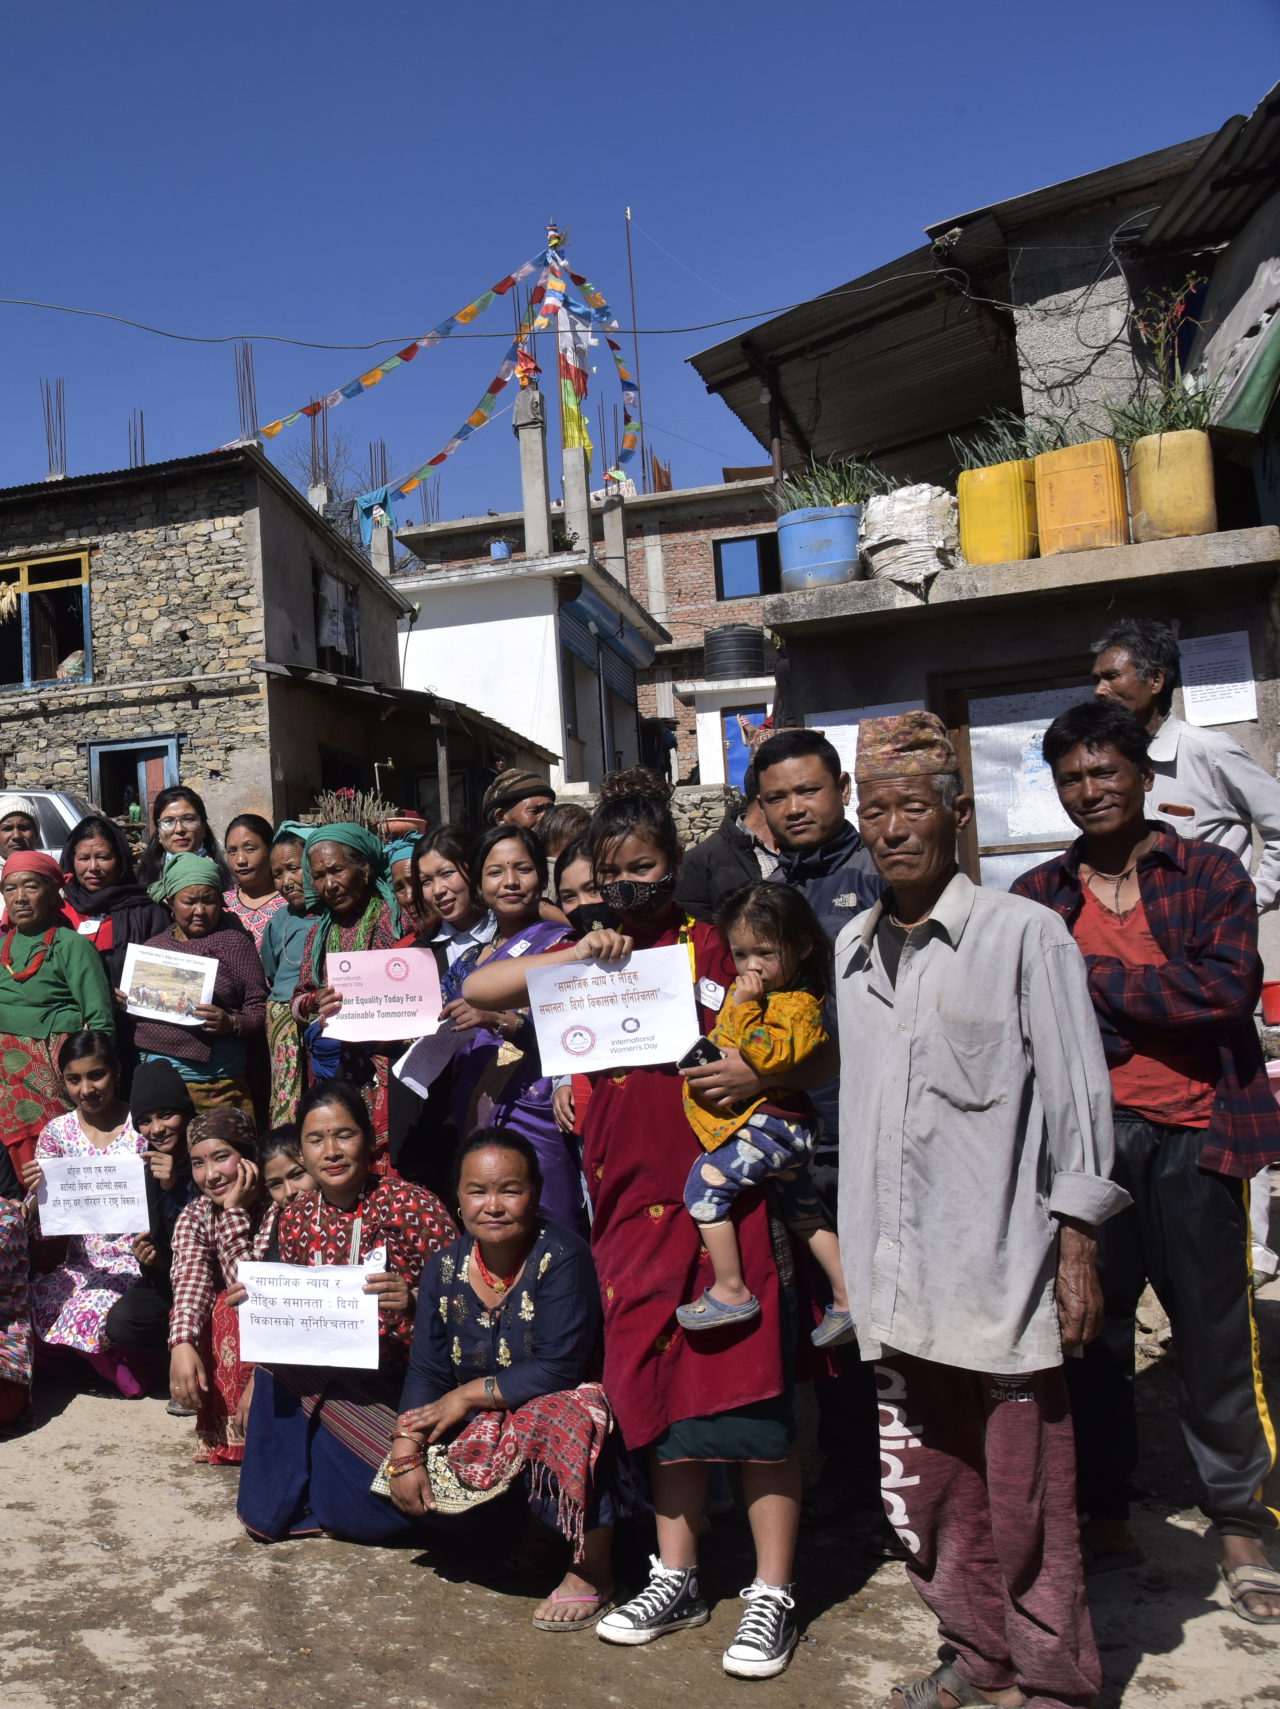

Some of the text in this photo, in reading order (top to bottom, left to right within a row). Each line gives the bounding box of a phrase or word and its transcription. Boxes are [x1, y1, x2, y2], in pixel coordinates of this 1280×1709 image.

[591, 975, 607, 988] न्याय
[610, 974, 616, 986] र
[355, 995, 382, 1007] Equality
[384, 994, 404, 1005] Today
[405, 993, 416, 1002] For
[570, 996, 585, 1012] दिगो
[587, 993, 618, 1009] विकासको
[335, 1010, 375, 1020] Sustainable
[611, 1034, 655, 1046] International
[610, 1042, 658, 1054] Women's Day
[306, 1278, 329, 1288] न्याय
[335, 1279, 342, 1289] र
[283, 1297, 323, 1309] समानता
[337, 1296, 359, 1310] दिगो
[250, 1313, 295, 1327] विकासको
[990, 1388, 1035, 1401] adidas
